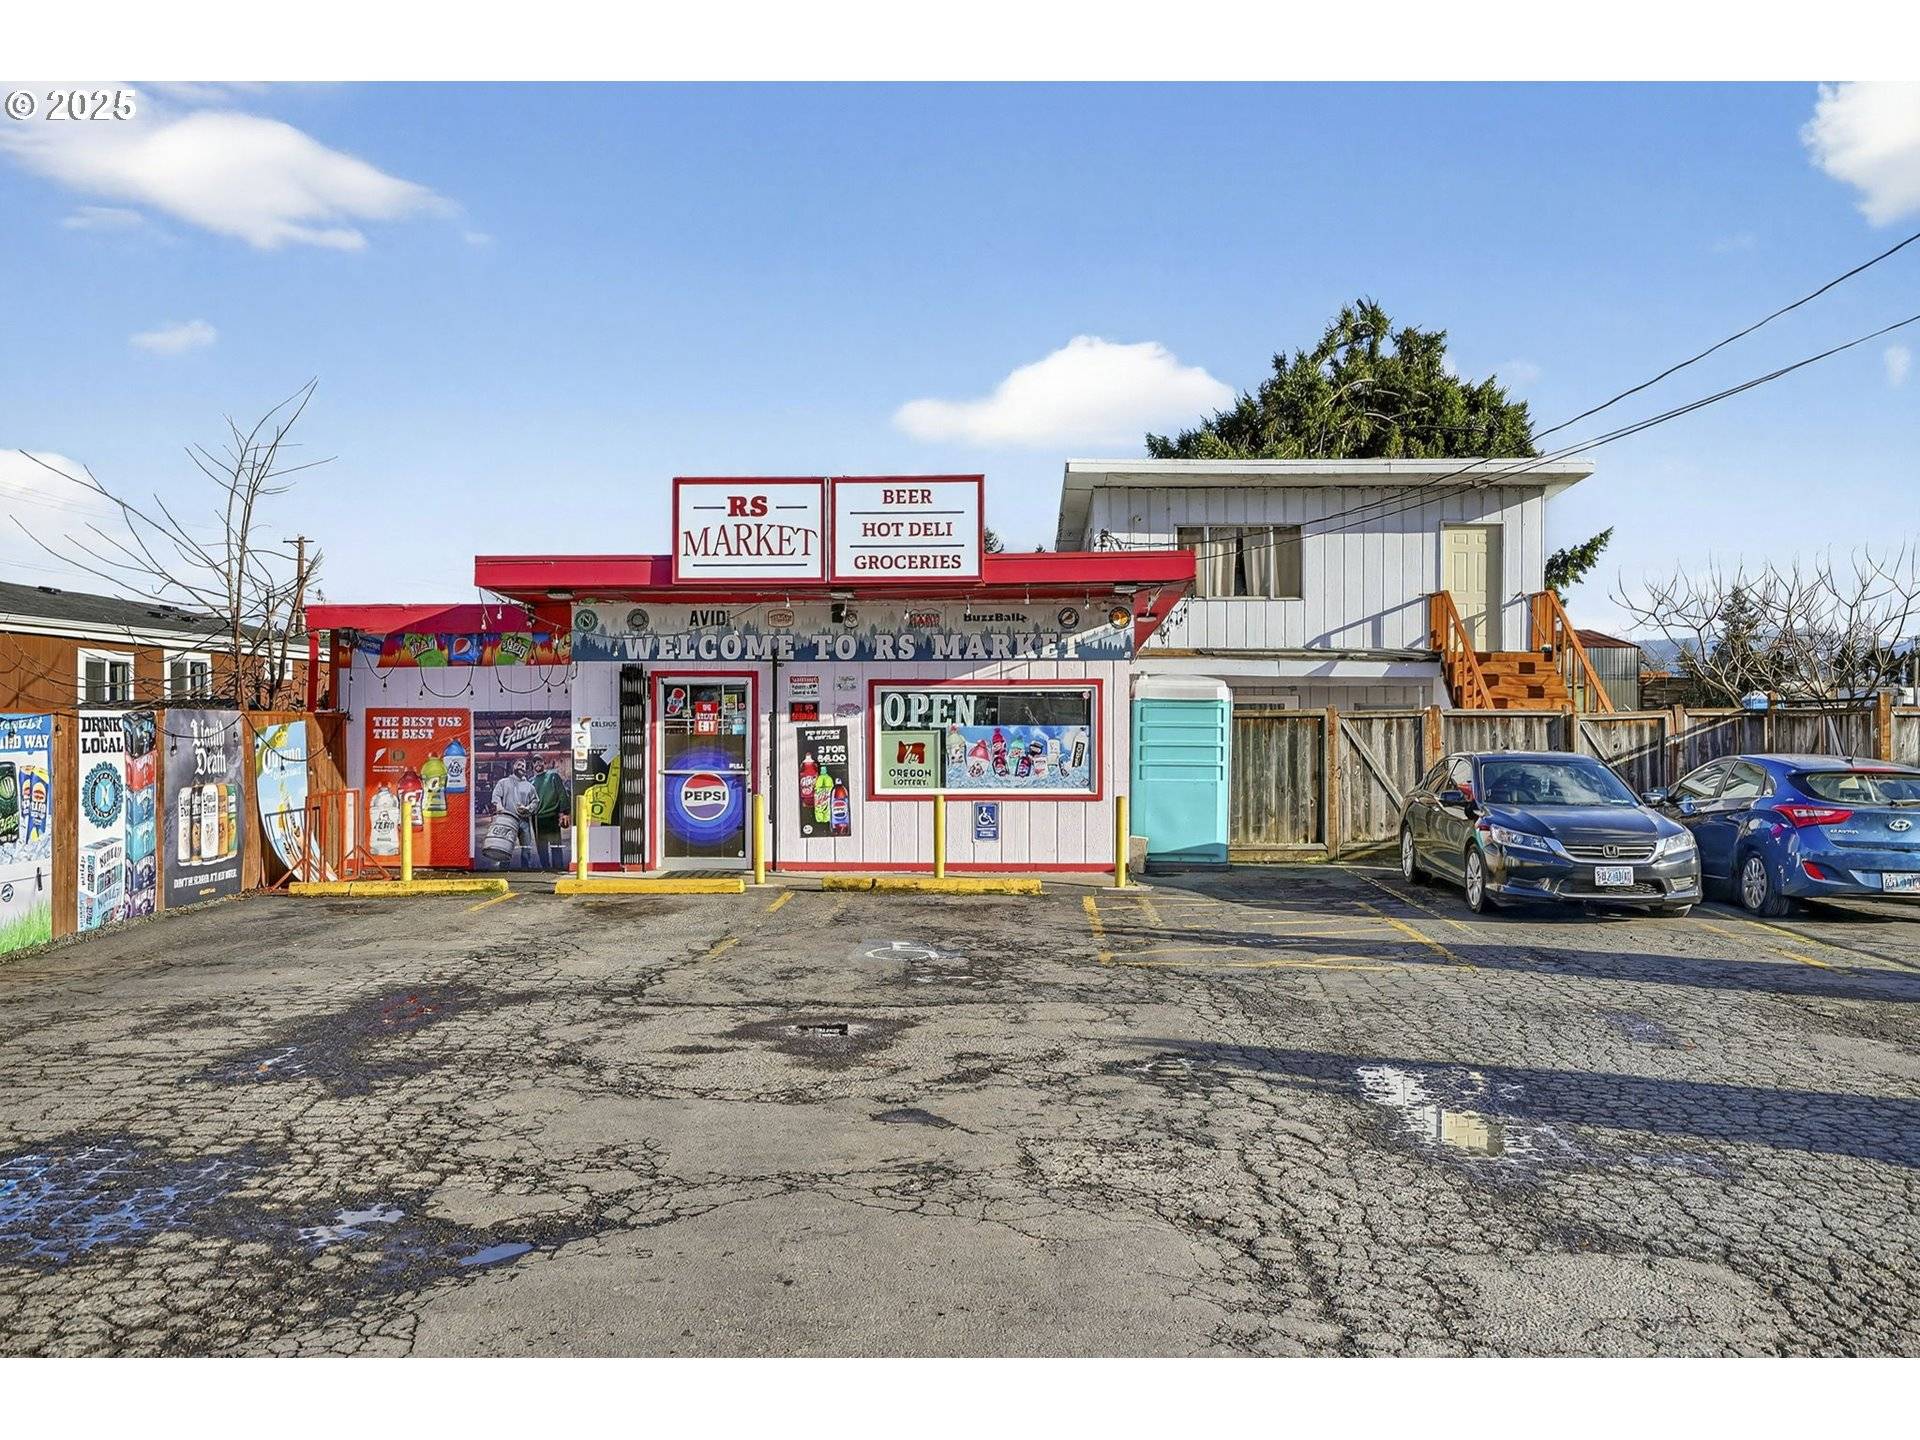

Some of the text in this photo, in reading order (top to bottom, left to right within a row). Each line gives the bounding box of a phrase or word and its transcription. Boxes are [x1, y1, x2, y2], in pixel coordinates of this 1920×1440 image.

[882, 489, 933, 505] BEER
[727, 495, 769, 517] RS
[862, 522, 953, 538] HOT DELI
[683, 523, 819, 557] MARKET
[854, 554, 962, 570] GROCERIES
[689, 610, 727, 626] AVID
[623, 633, 1081, 660] WELCOME TO RS MARKET
[883, 693, 977, 728] OPEN
[81, 717, 122, 732] DRINK
[373, 716, 463, 727] THE BEST USE
[23, 734, 50, 749] WAY
[373, 729, 434, 739] THE BEST
[82, 737, 124, 753] LOCAL
[889, 769, 932, 777] OREGON
[684, 790, 727, 801] PEPSI
